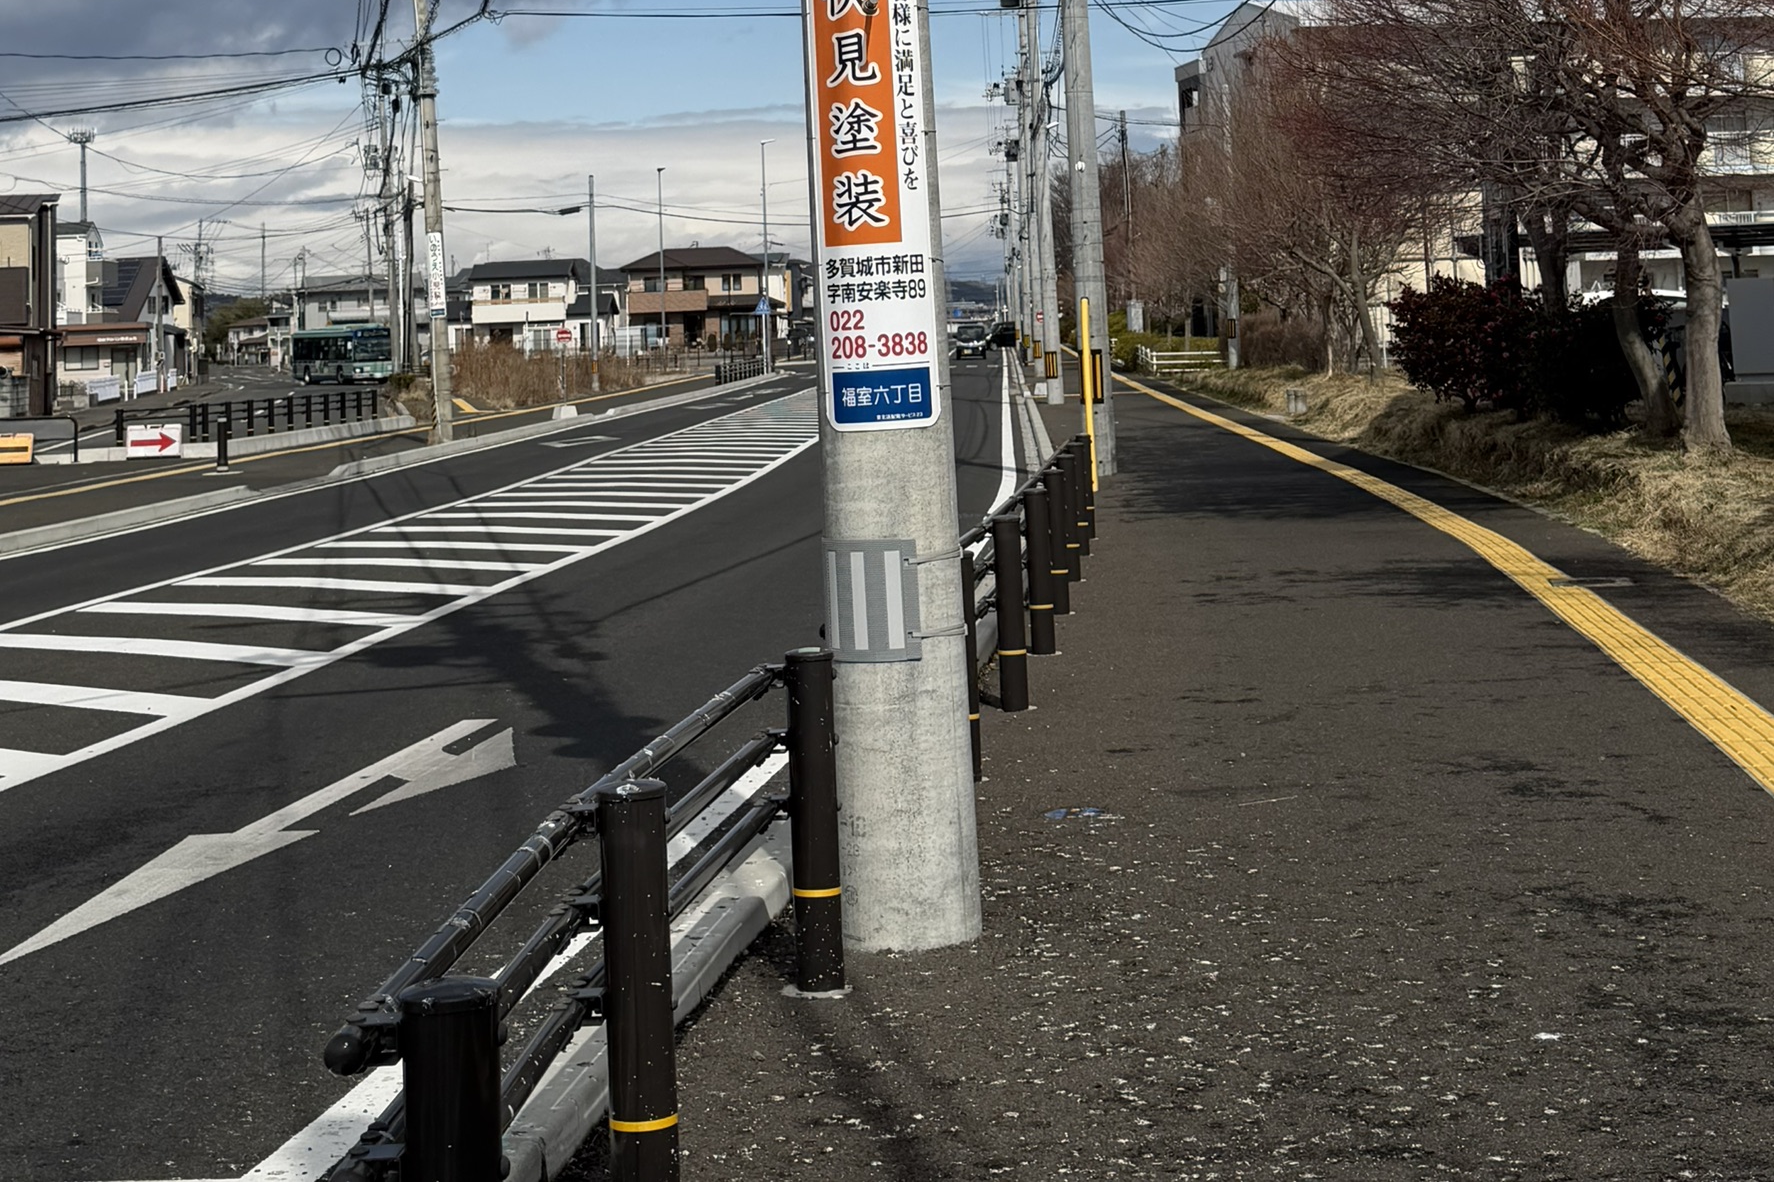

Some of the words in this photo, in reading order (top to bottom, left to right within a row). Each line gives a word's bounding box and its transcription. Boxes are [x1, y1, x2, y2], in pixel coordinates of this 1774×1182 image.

[825, 254, 925, 279] 多賀城市新田
[827, 278, 926, 304] 字南安楽寺89
[830, 309, 865, 332] 022
[831, 331, 928, 359] 208-3838
[841, 383, 922, 407] 福室六丁目
